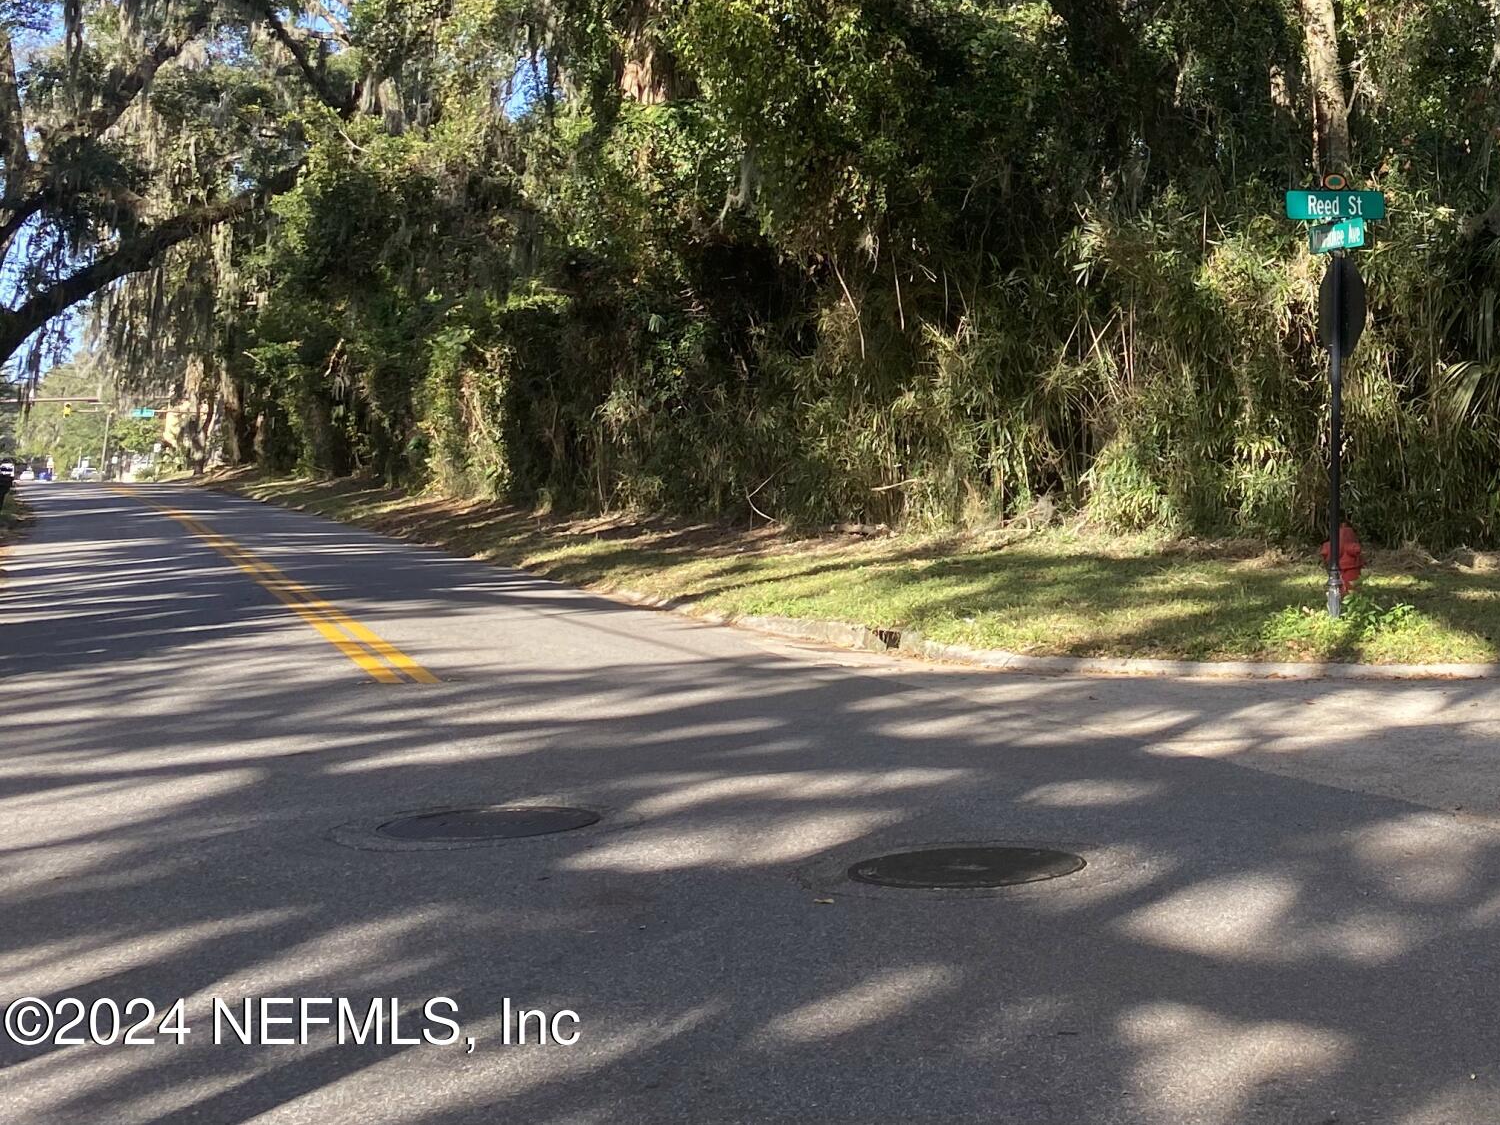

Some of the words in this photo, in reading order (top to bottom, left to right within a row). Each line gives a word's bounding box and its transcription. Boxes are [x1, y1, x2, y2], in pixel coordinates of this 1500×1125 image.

[1308, 195, 1340, 215] Reed
[1348, 195, 1363, 215] St
[1348, 223, 1361, 244] Ave
